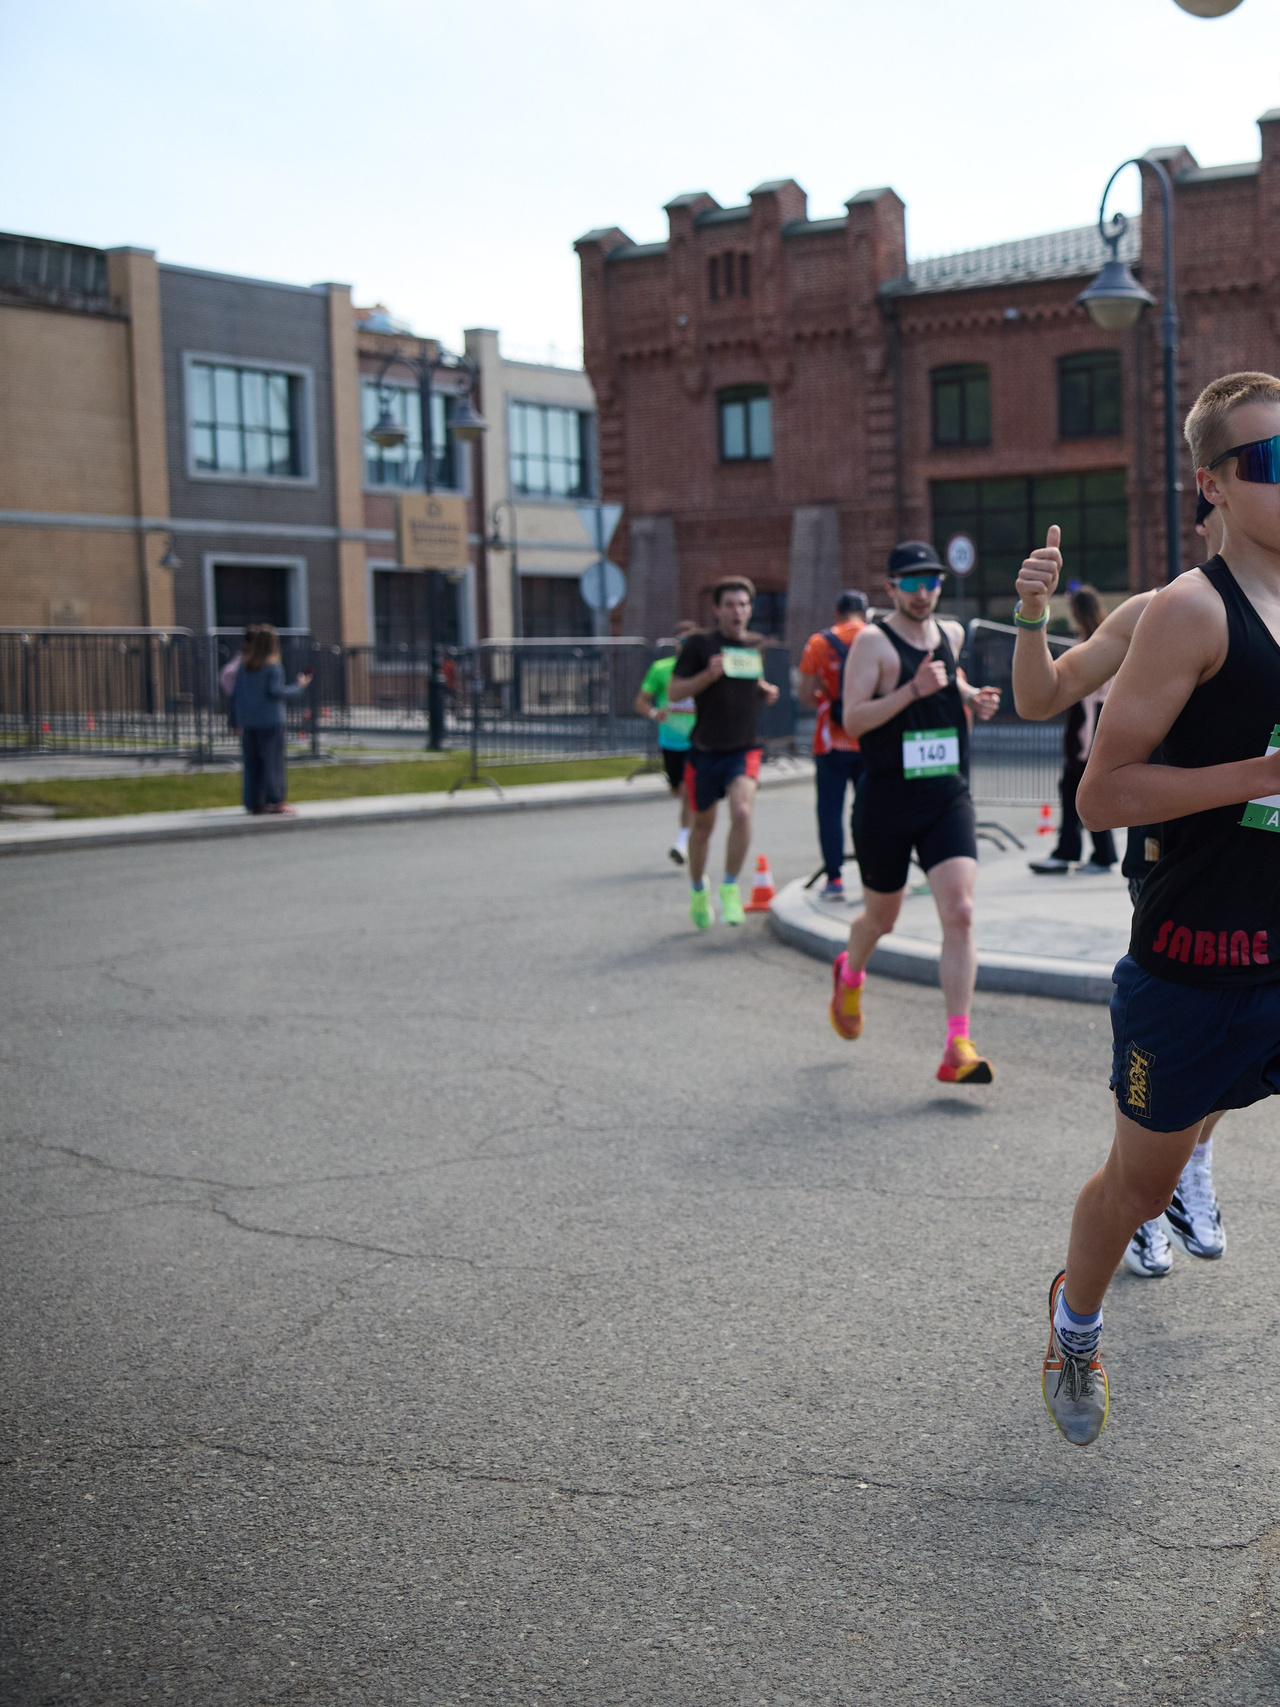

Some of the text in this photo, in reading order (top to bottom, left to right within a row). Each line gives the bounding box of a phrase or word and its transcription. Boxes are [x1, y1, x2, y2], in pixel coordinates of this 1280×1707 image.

[918, 744, 946, 762] 140
[1266, 810, 1279, 827] A
[1152, 920, 1269, 965] SABINE
